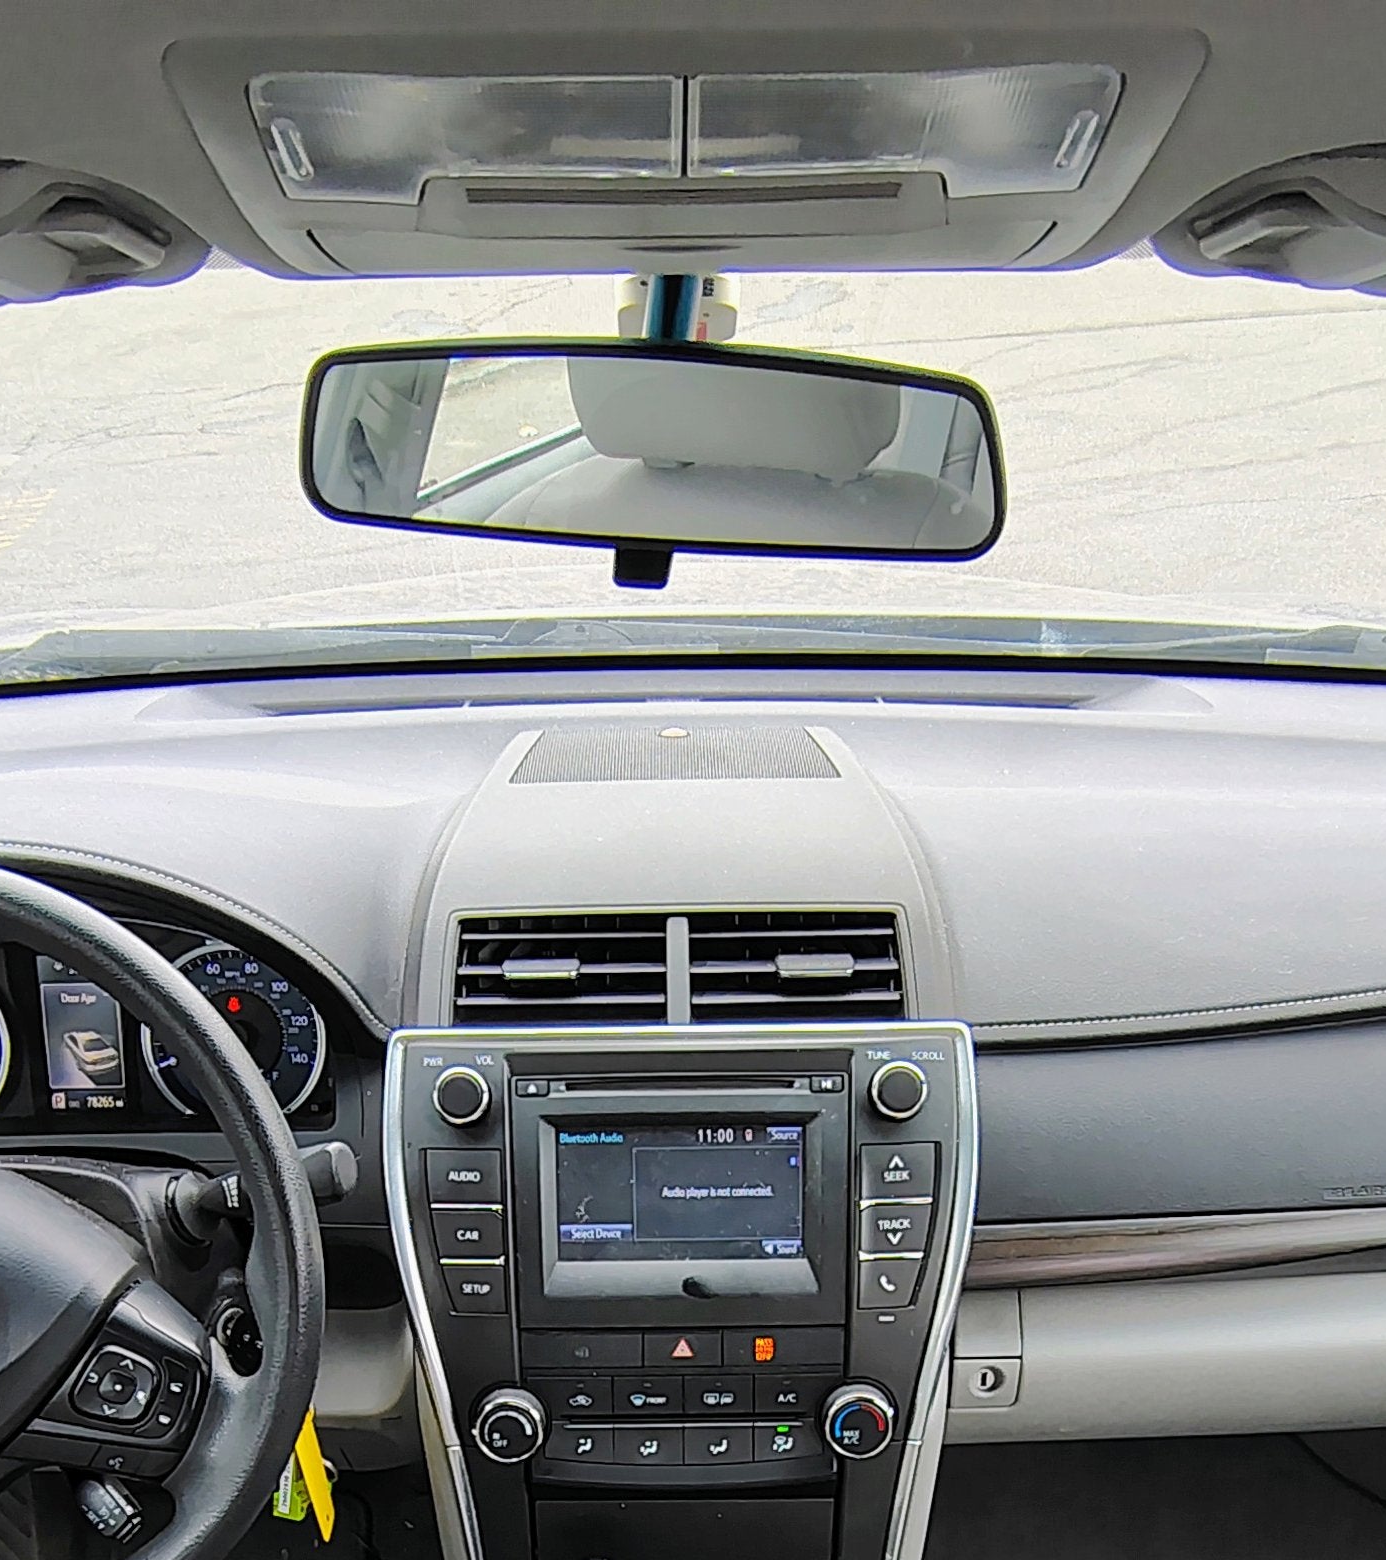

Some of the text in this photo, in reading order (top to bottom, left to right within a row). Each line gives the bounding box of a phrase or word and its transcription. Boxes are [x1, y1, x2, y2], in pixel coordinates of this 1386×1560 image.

[206, 963, 220, 975] 60
[244, 963, 259, 974] 80
[271, 981, 289, 993] 100
[291, 1016, 308, 1027] 120
[291, 1053, 308, 1064] 140
[423, 1055, 495, 1067] PWR VOL
[866, 1050, 945, 1061] TUNE SCROLL
[272, 1071, 280, 1081] F
[697, 1128, 734, 1143] 11:00
[448, 1171, 481, 1182] AUDIO
[883, 1170, 911, 1183] SEEK
[877, 1218, 912, 1231] TRACK
[456, 1230, 480, 1240] CAR
[461, 1283, 491, 1294] SETUP
[777, 1393, 797, 1403] A/C
[493, 1440, 508, 1448] OFF
